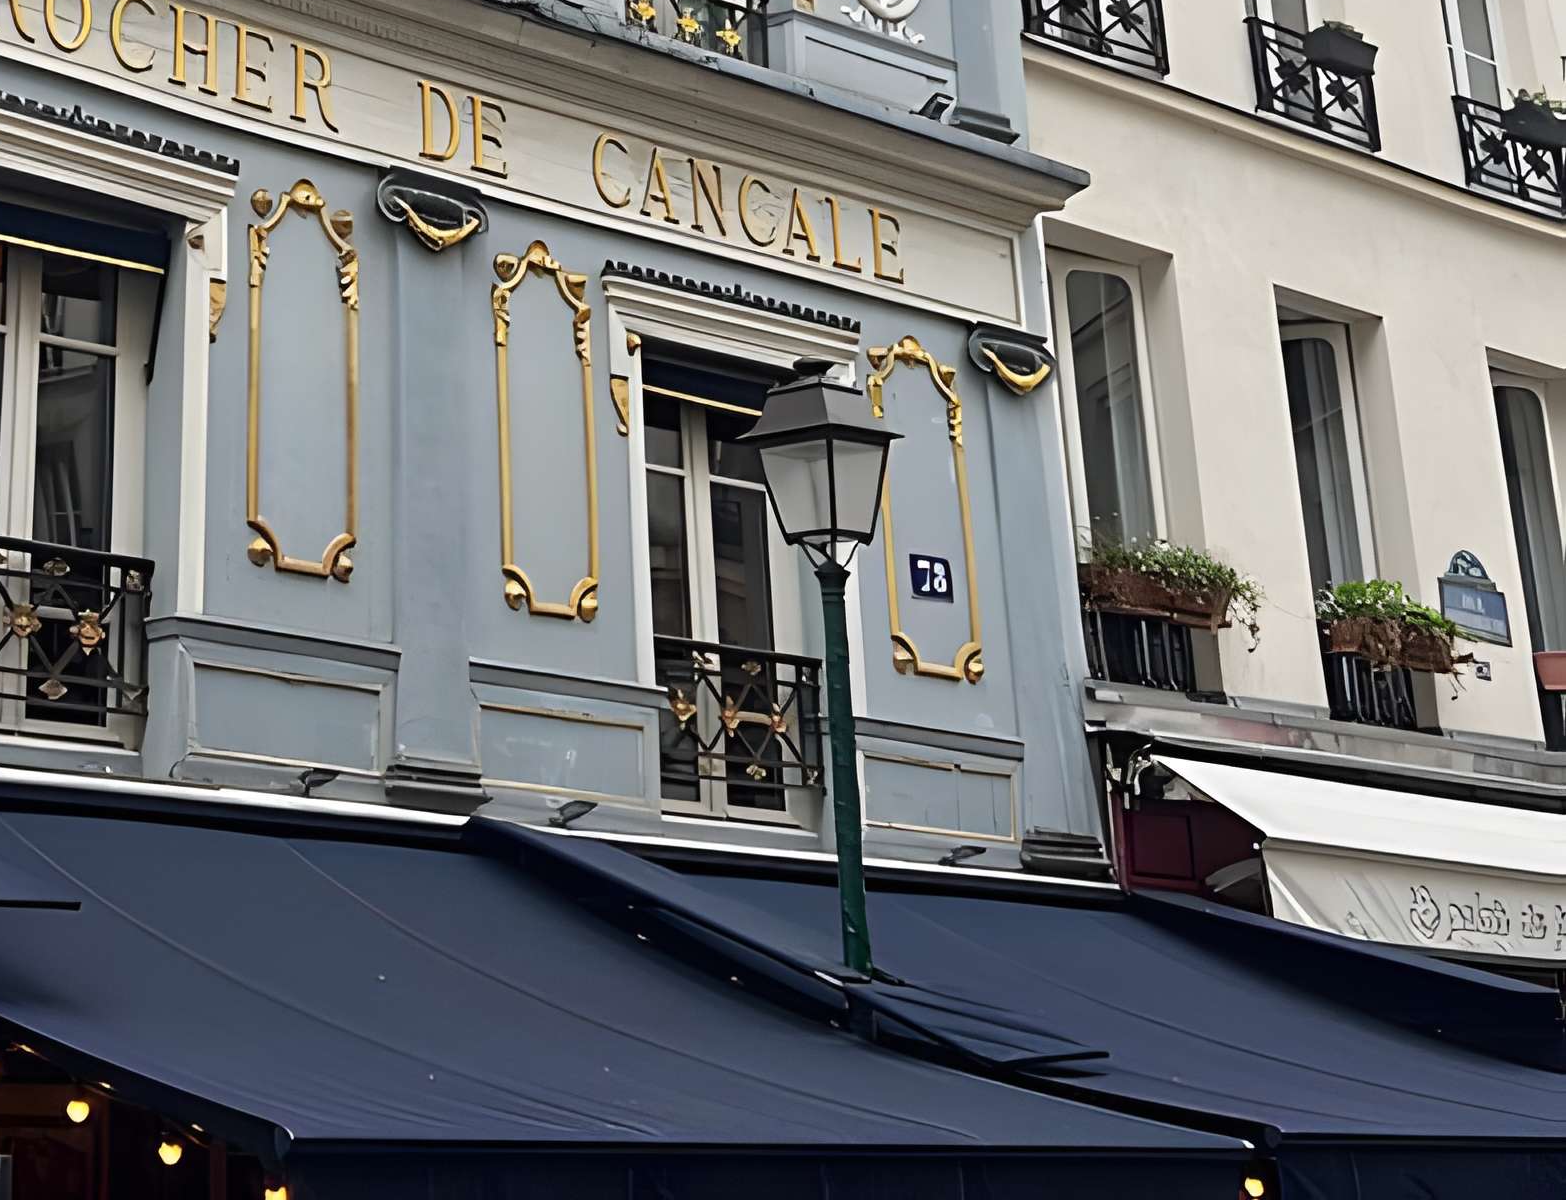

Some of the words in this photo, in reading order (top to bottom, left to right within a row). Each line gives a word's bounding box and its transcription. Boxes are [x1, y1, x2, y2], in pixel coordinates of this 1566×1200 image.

[417, 79, 509, 179] DE
[592, 132, 905, 284] CANCALE
[917, 559, 948, 593] 78
